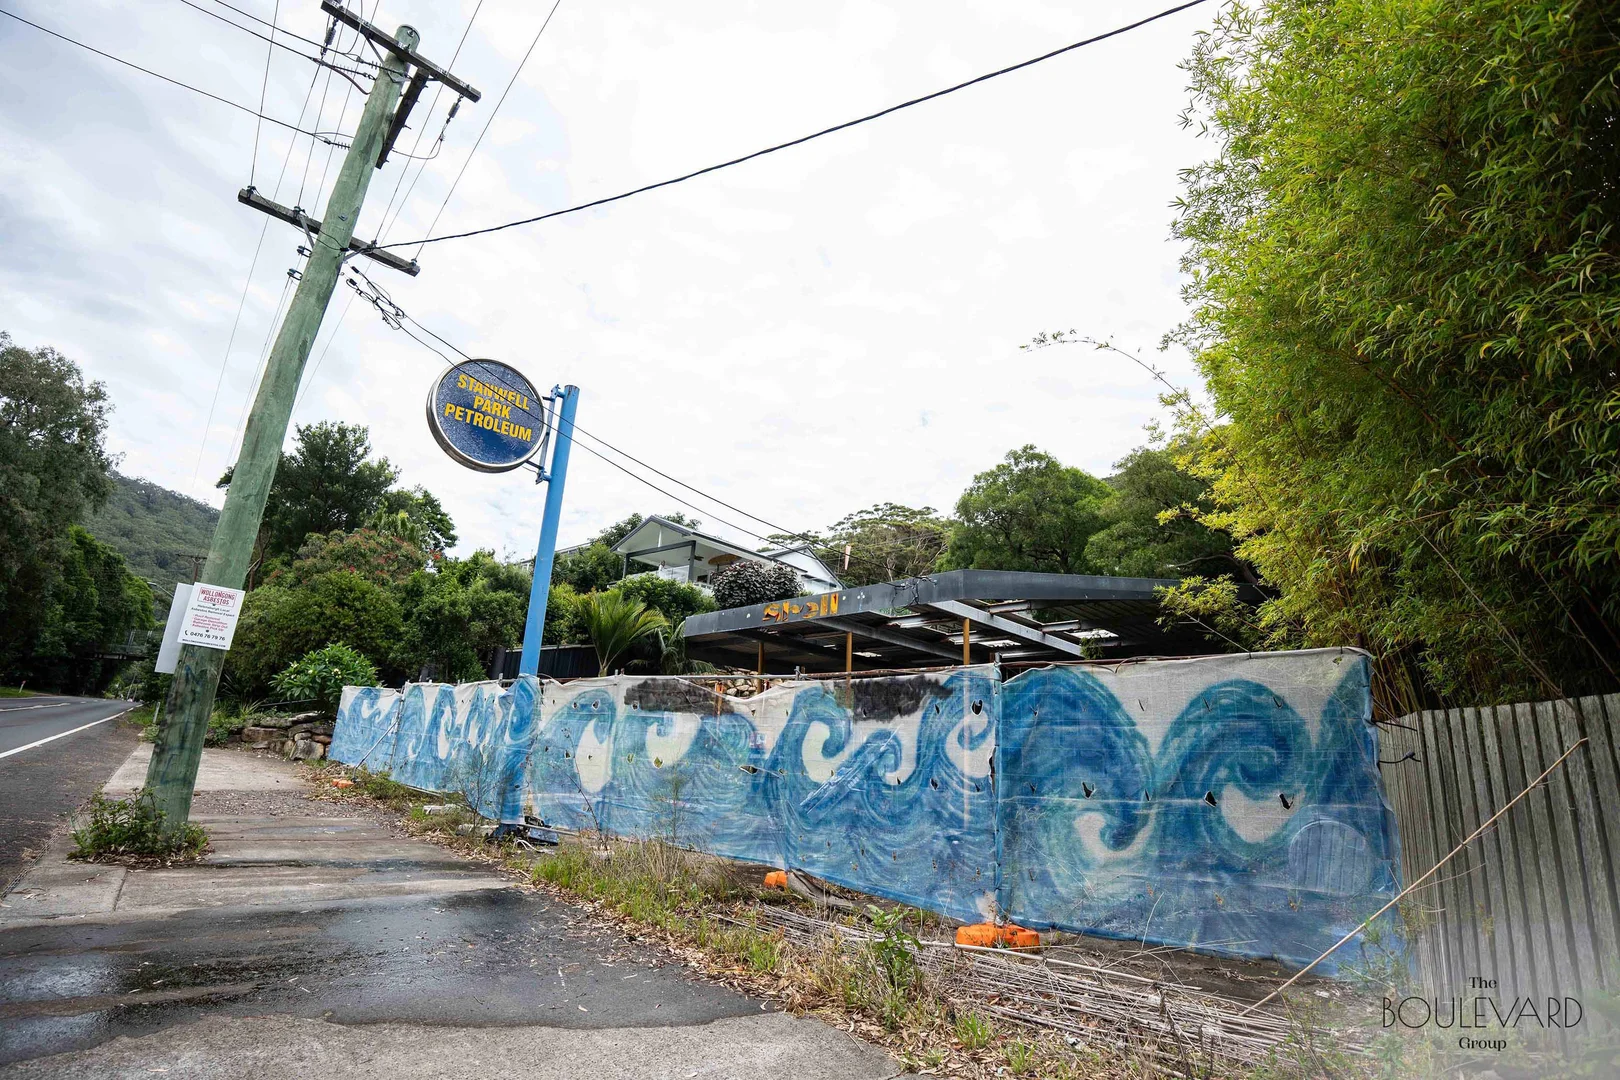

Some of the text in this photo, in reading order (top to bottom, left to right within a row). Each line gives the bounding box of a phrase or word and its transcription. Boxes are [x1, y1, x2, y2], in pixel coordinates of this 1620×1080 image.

[458, 374, 530, 411] STANWELL
[473, 395, 511, 419] PARK
[444, 403, 532, 442] PETROLEUM
[203, 596, 229, 605] ASBESTOS
